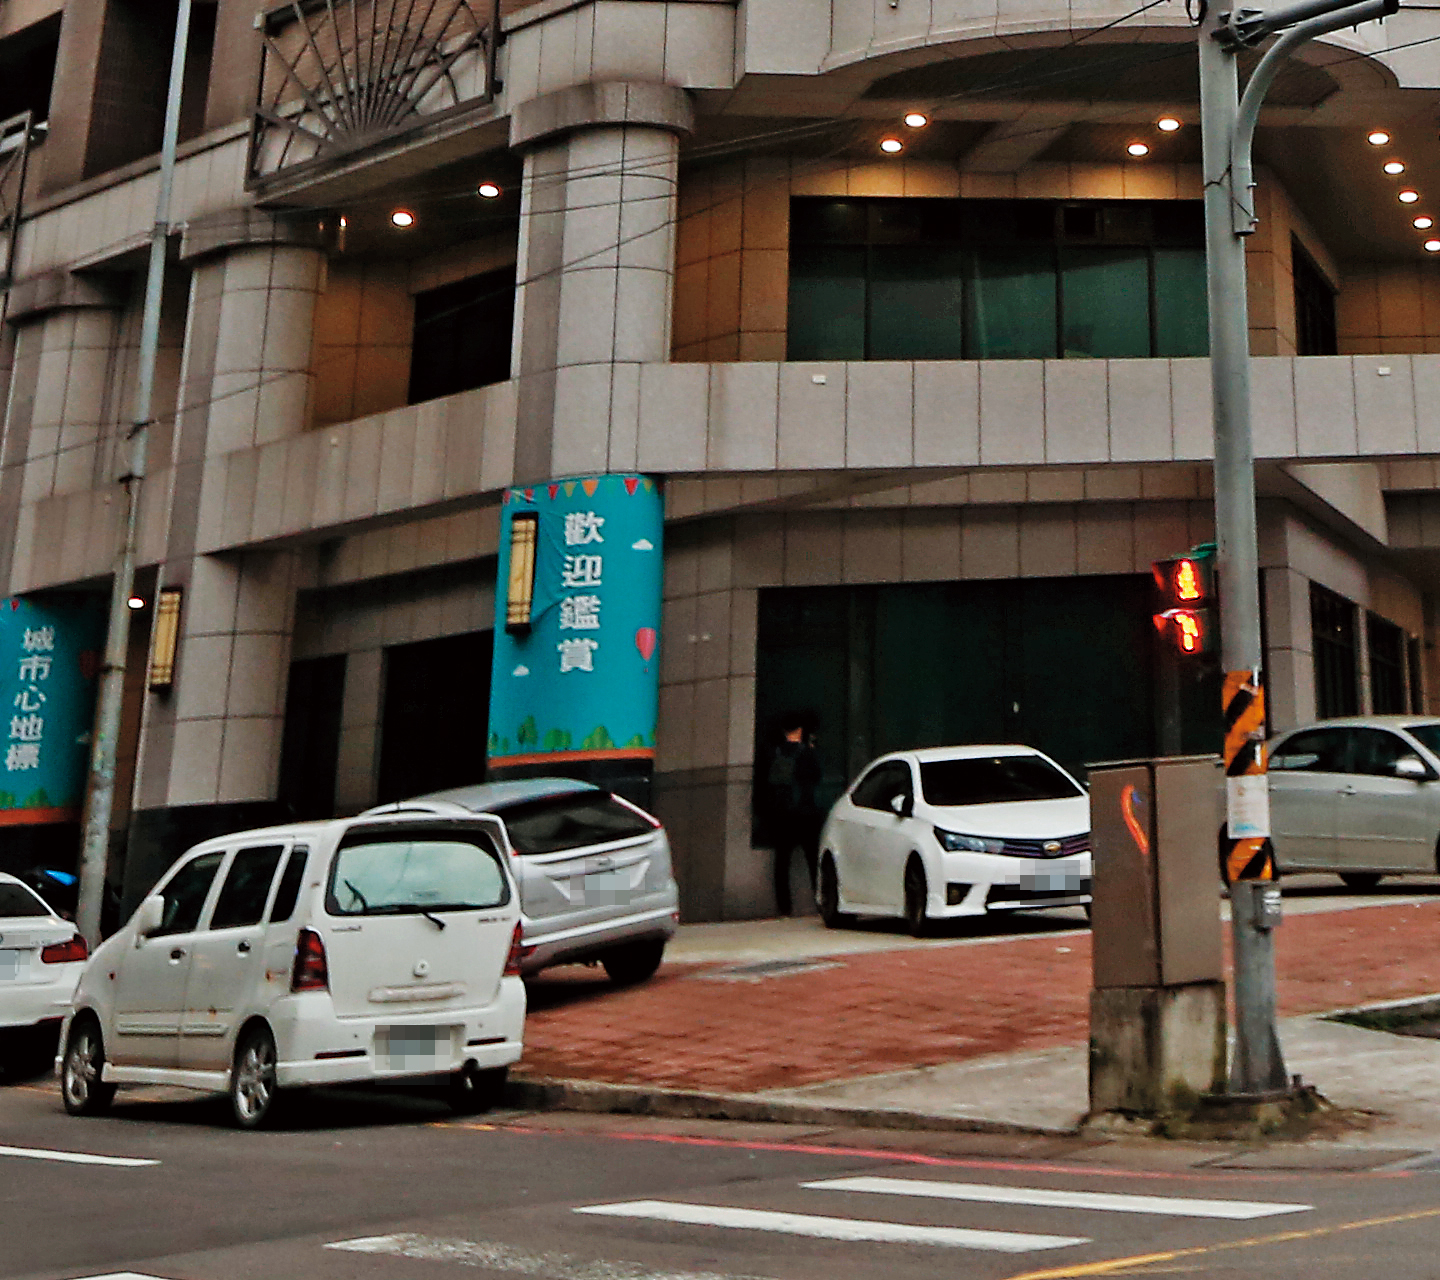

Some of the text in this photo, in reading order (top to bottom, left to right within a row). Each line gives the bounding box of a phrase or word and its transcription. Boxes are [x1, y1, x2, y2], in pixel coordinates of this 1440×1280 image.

[558, 511, 605, 672] 歡迎鑑賞
[5, 626, 54, 771] 城市心地標
